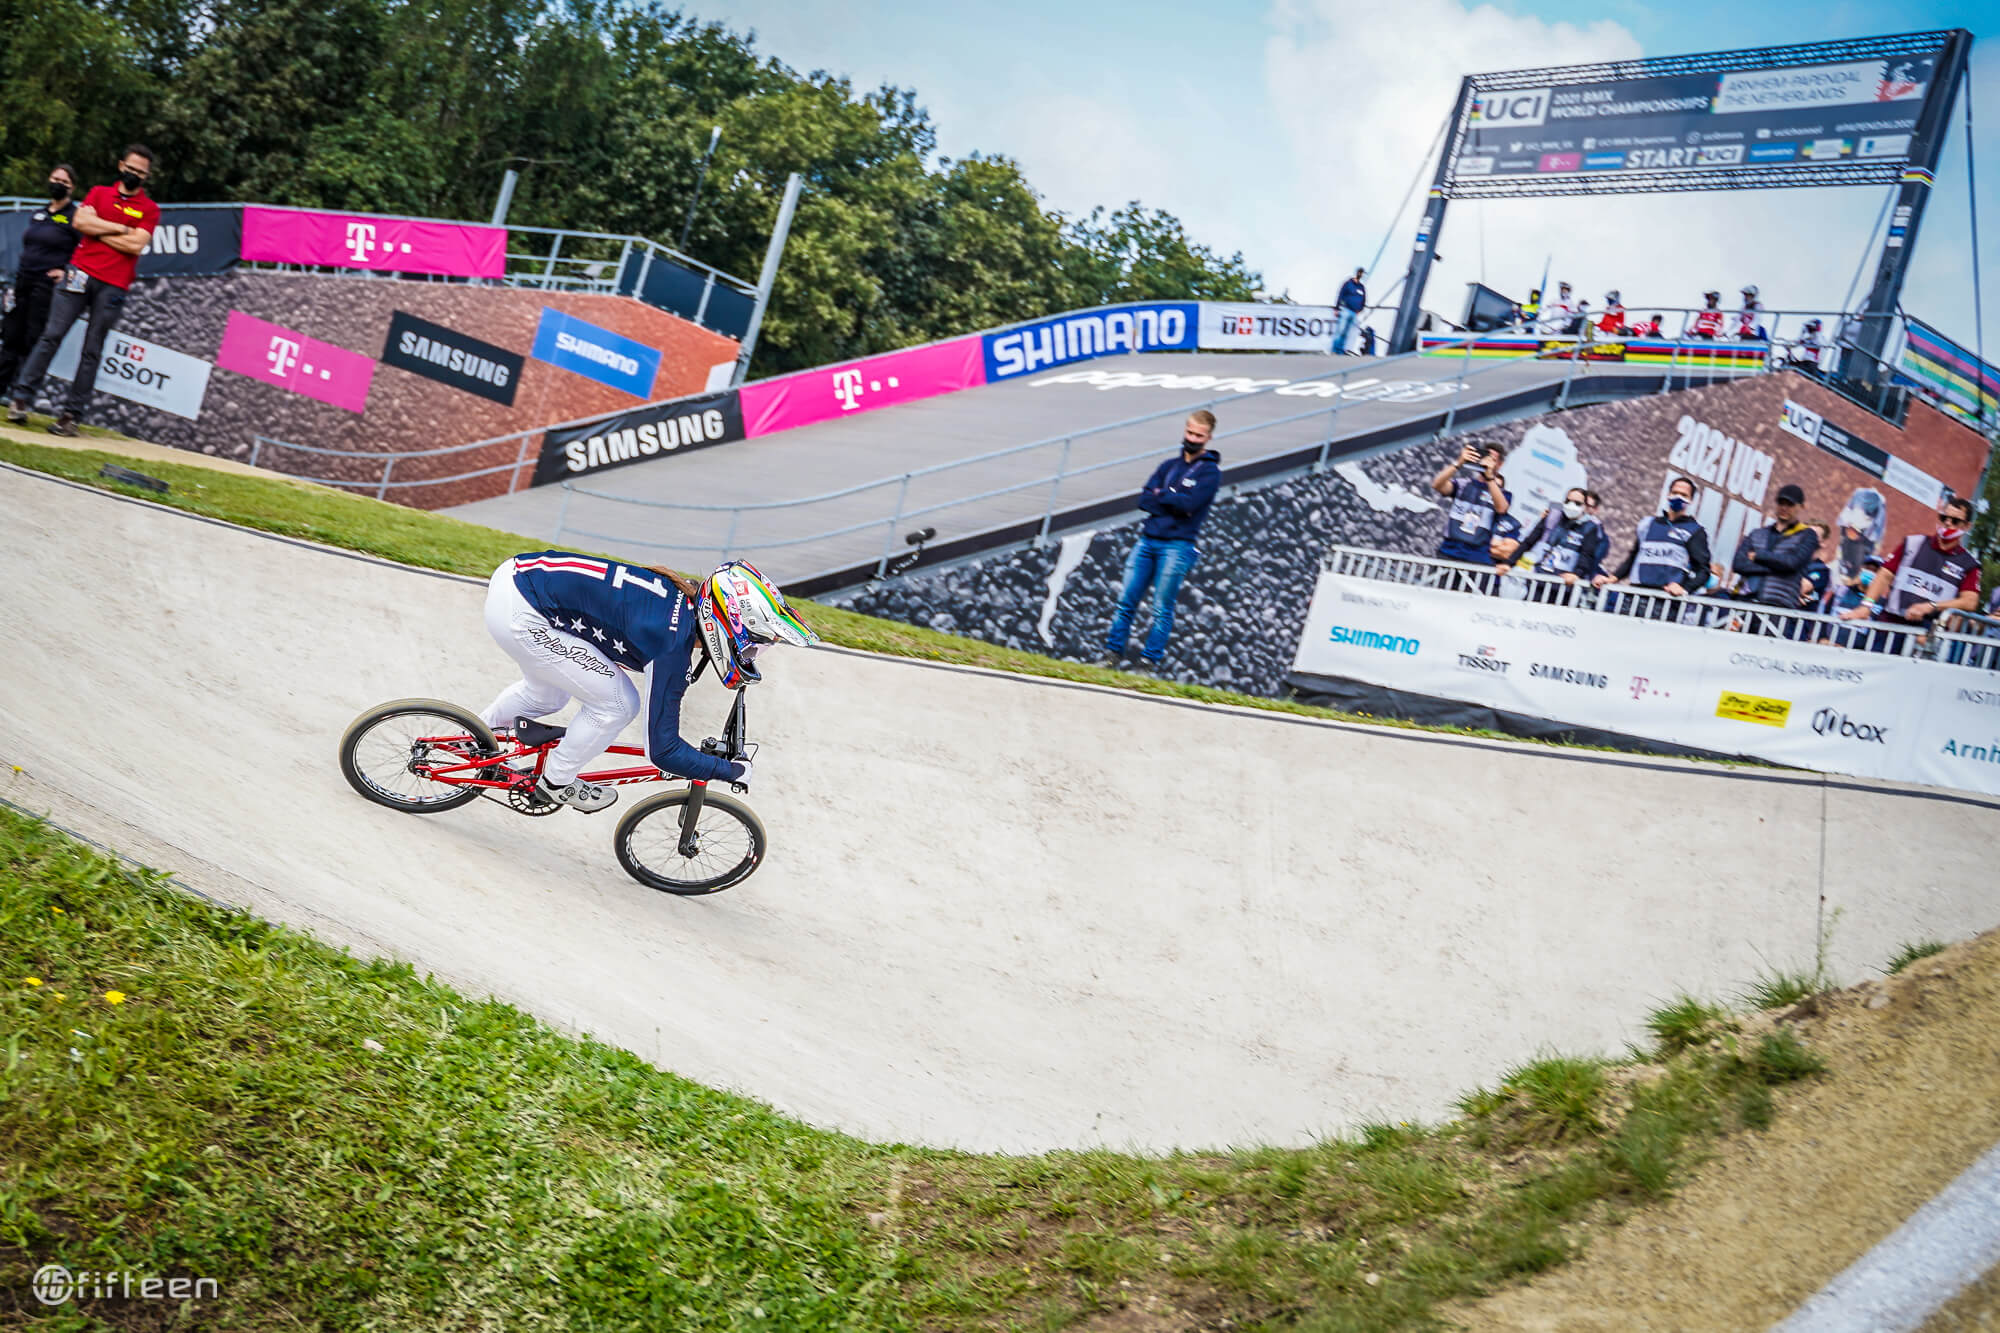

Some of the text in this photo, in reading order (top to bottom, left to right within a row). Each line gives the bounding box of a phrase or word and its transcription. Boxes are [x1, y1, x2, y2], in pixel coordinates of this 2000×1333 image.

[1485, 96, 1542, 120] UCI
[1550, 96, 1710, 118] WORLD CHAMPIONSHIPS
[1626, 147, 1699, 168] START
[993, 309, 1186, 377] SHIMANO
[1257, 318, 1338, 338] TISSOT
[399, 330, 511, 388] SAMSUNG
[554, 332, 639, 377] SHIMANO
[1788, 407, 1818, 436] UCI
[565, 408, 725, 473] SAMSUNG
[1668, 415, 1736, 488] 2021
[1726, 441, 1775, 507] UCI
[611, 564, 669, 599] 1
[1907, 573, 1944, 596] TEAM
[1329, 625, 1420, 656] SHIMANO
[1470, 612, 1577, 639] OFFICIAL PARTNERS
[565, 645, 615, 678] Designs
[709, 633, 721, 661] TOYOTA
[1457, 654, 1511, 674] TISSOT
[1529, 662, 1608, 689] SAMSUNG
[1729, 651, 1865, 685] OFFICIAL SUPPLIERS
[1840, 713, 1891, 745] box
